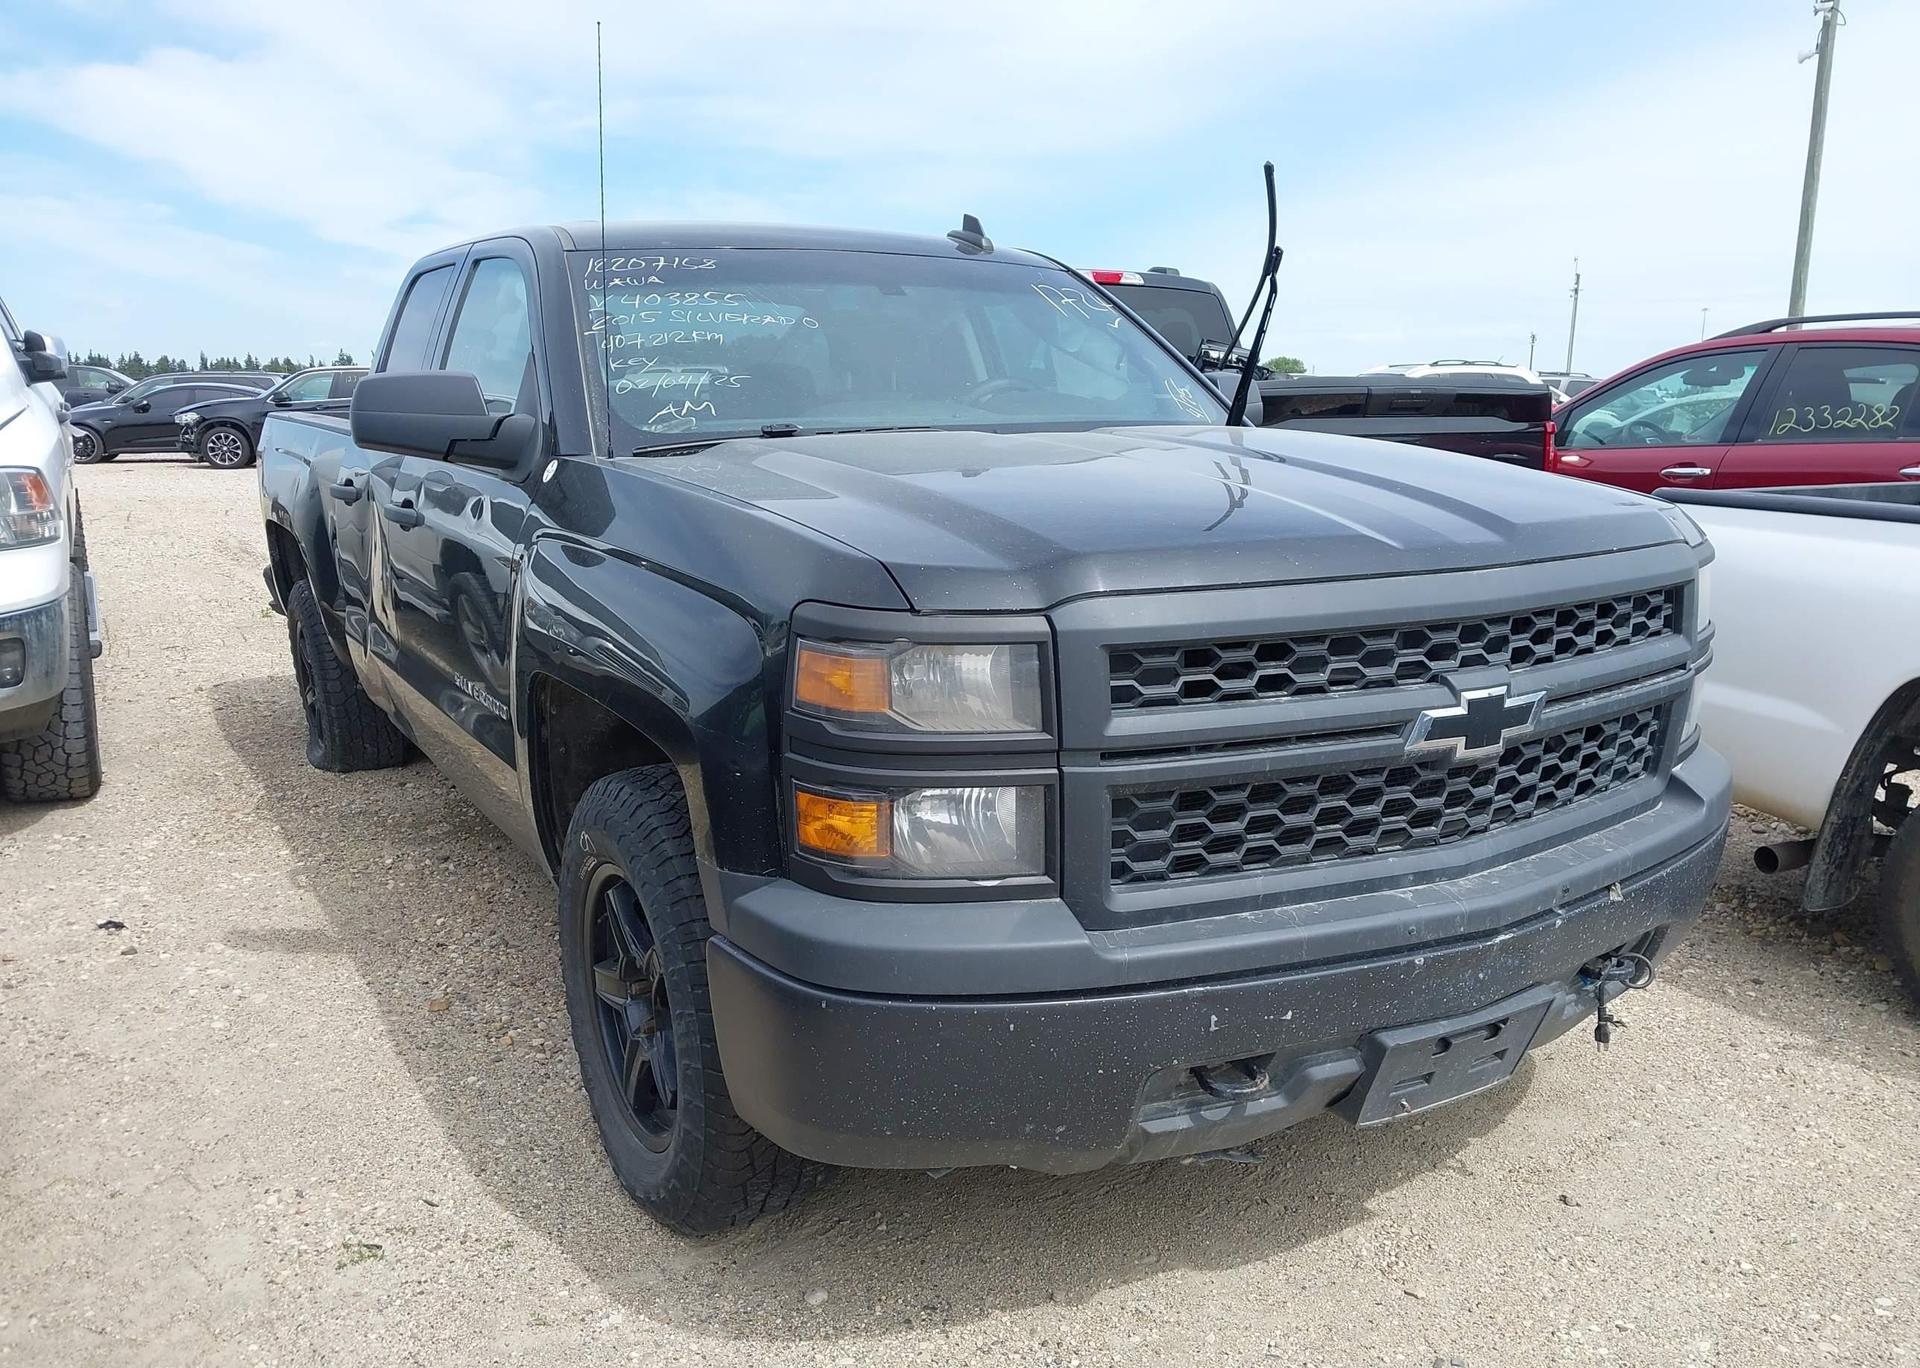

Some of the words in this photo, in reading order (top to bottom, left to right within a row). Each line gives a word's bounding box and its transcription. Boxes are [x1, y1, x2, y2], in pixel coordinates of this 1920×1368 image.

[591, 311, 662, 331] 2015
[669, 309, 820, 329] SILVERADO
[1768, 403, 1901, 436] 12332282
